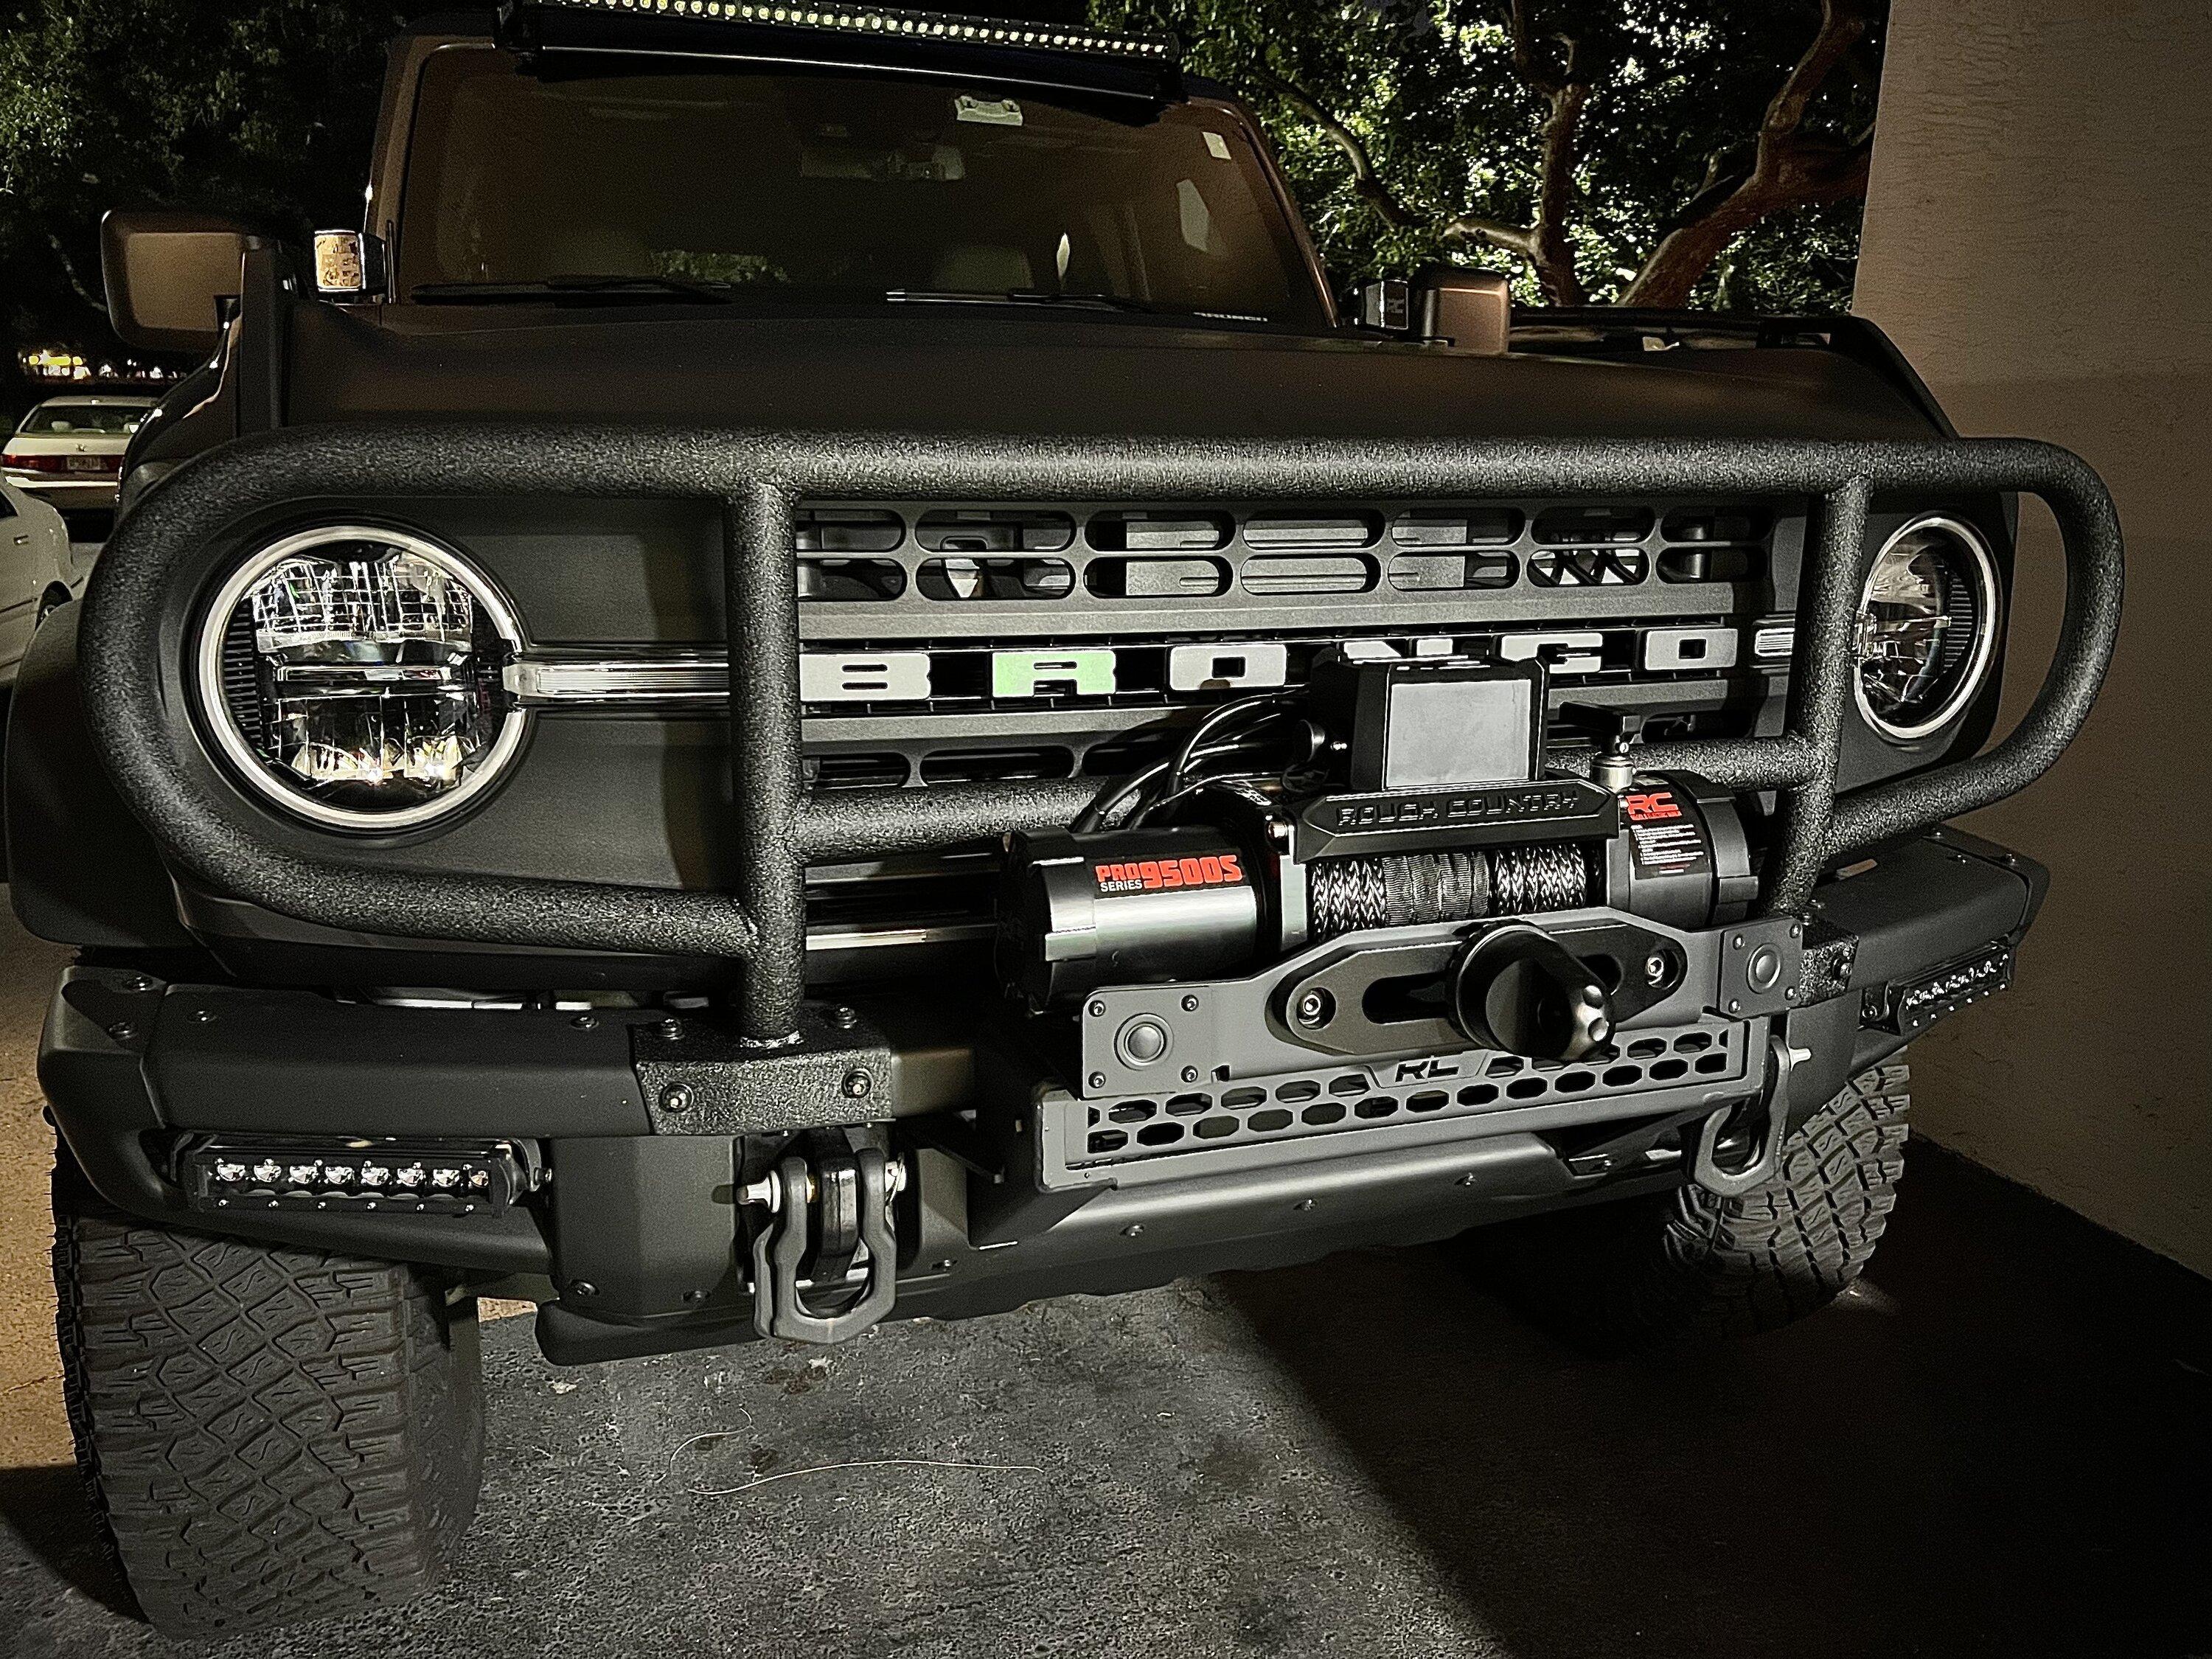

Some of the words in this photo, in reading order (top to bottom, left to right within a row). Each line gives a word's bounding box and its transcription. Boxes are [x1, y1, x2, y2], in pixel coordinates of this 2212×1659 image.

[1336, 801, 1439, 826] ROUGH
[1446, 790, 1579, 818] COUNTRY
[1625, 792, 1679, 815] RC
[1100, 879, 1143, 893] SERIES
